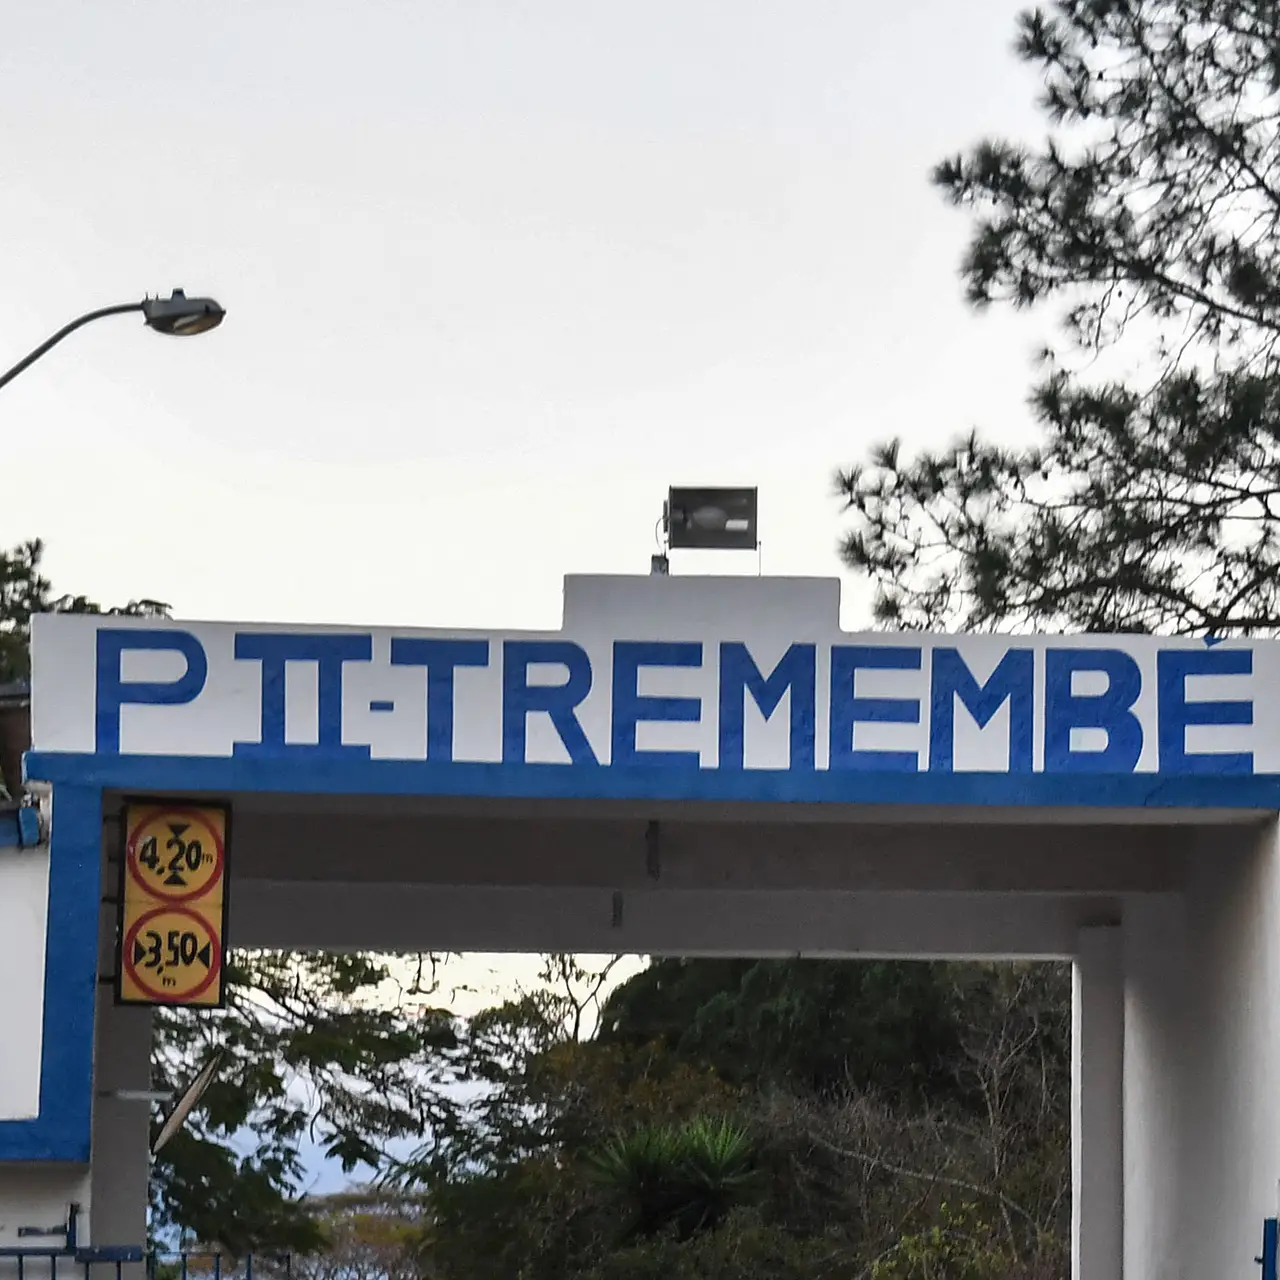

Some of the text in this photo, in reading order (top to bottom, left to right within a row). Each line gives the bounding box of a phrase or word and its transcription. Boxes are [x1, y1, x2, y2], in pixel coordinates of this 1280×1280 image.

[96, 628, 207, 756] P
[144, 930, 198, 974] 3,50
[163, 976, 176, 987] m
